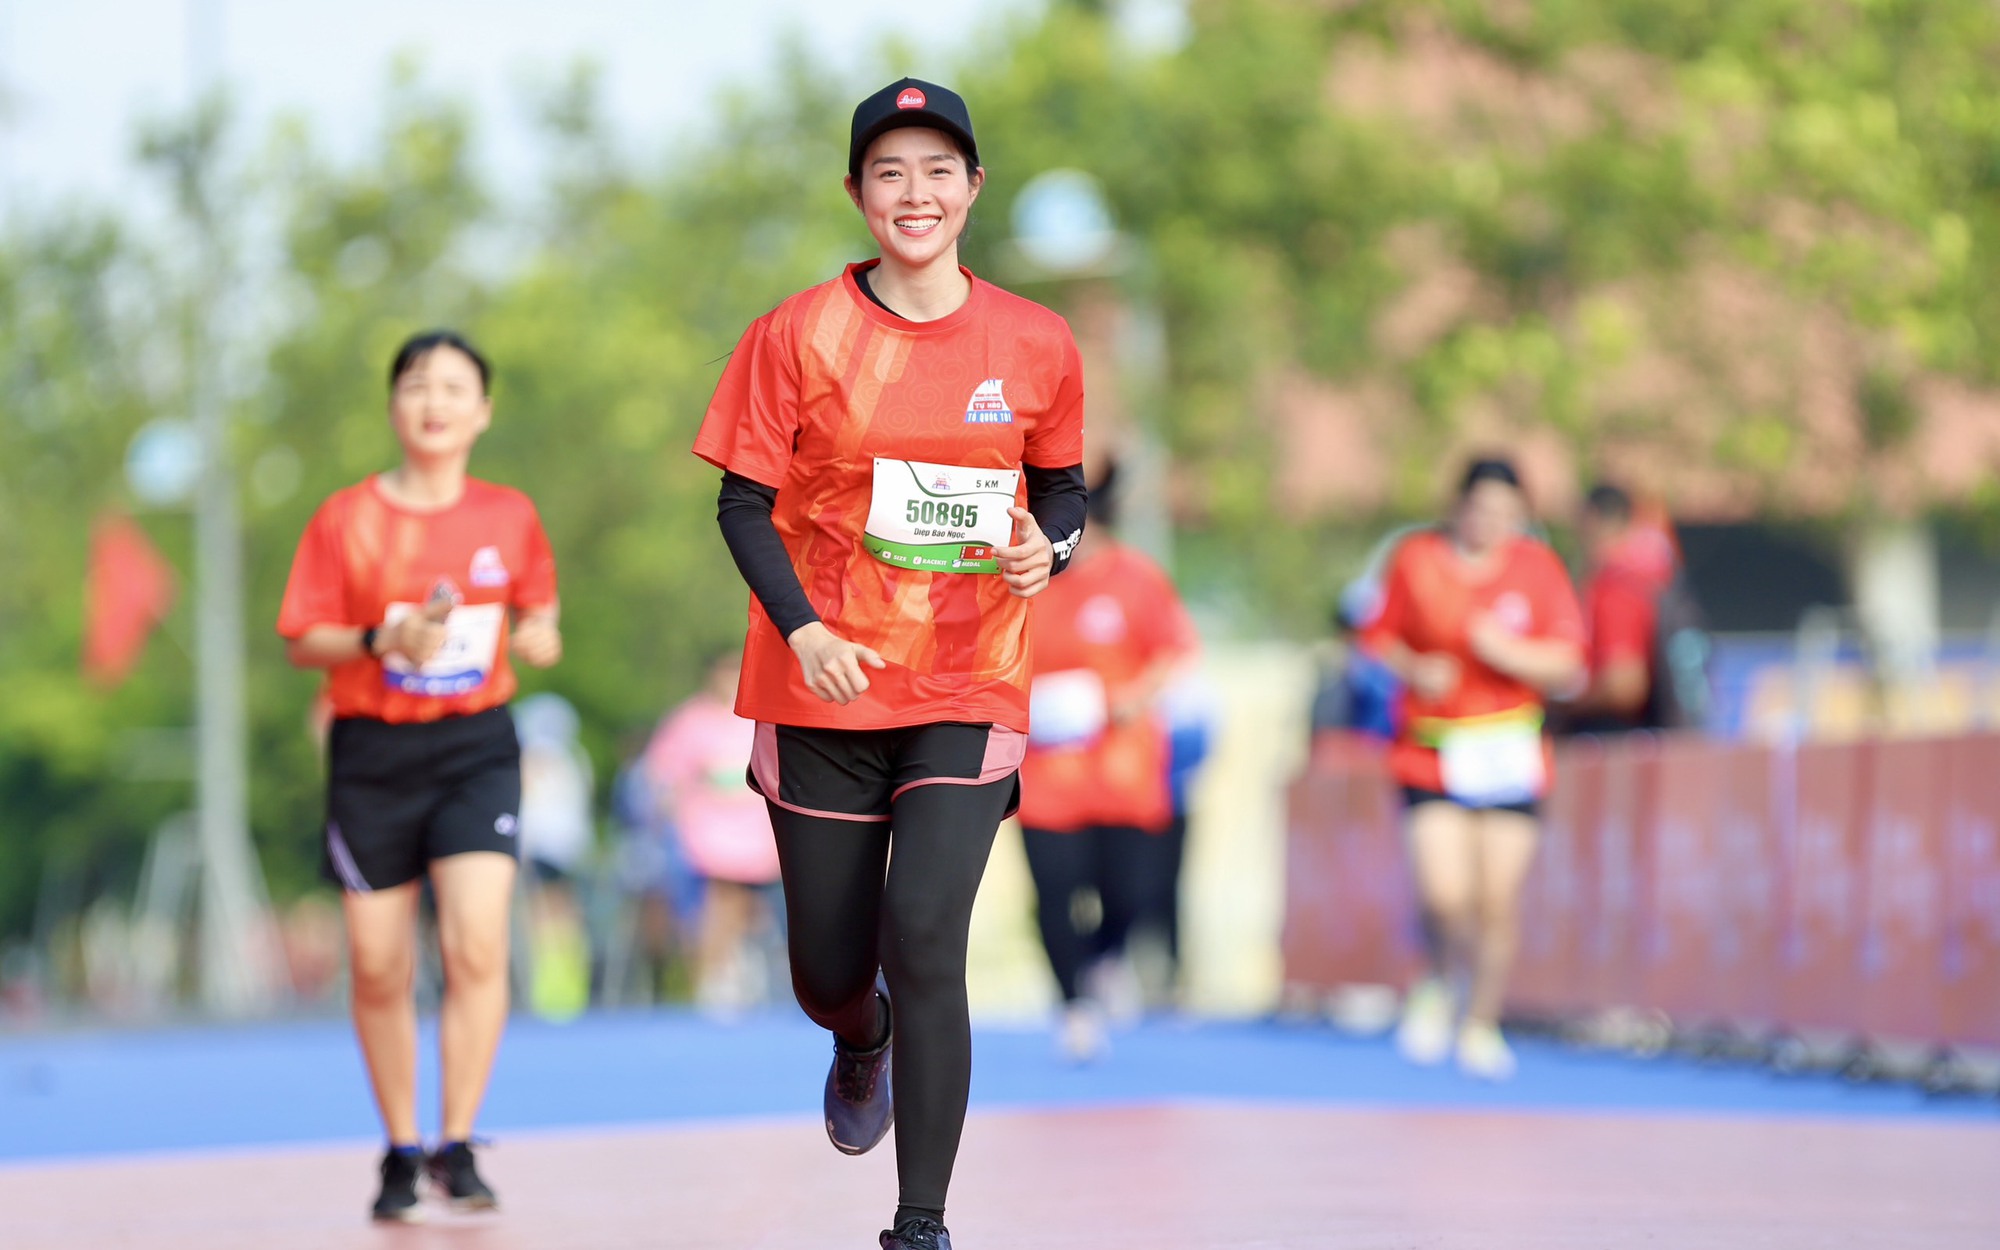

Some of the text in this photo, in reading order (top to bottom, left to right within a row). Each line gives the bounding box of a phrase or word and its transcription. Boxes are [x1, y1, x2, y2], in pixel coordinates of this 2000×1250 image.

[899, 95, 922, 104] Leica
[976, 480, 999, 488] 5 KM
[906, 499, 979, 528] 50895
[922, 558, 947, 566] RACEKIT
